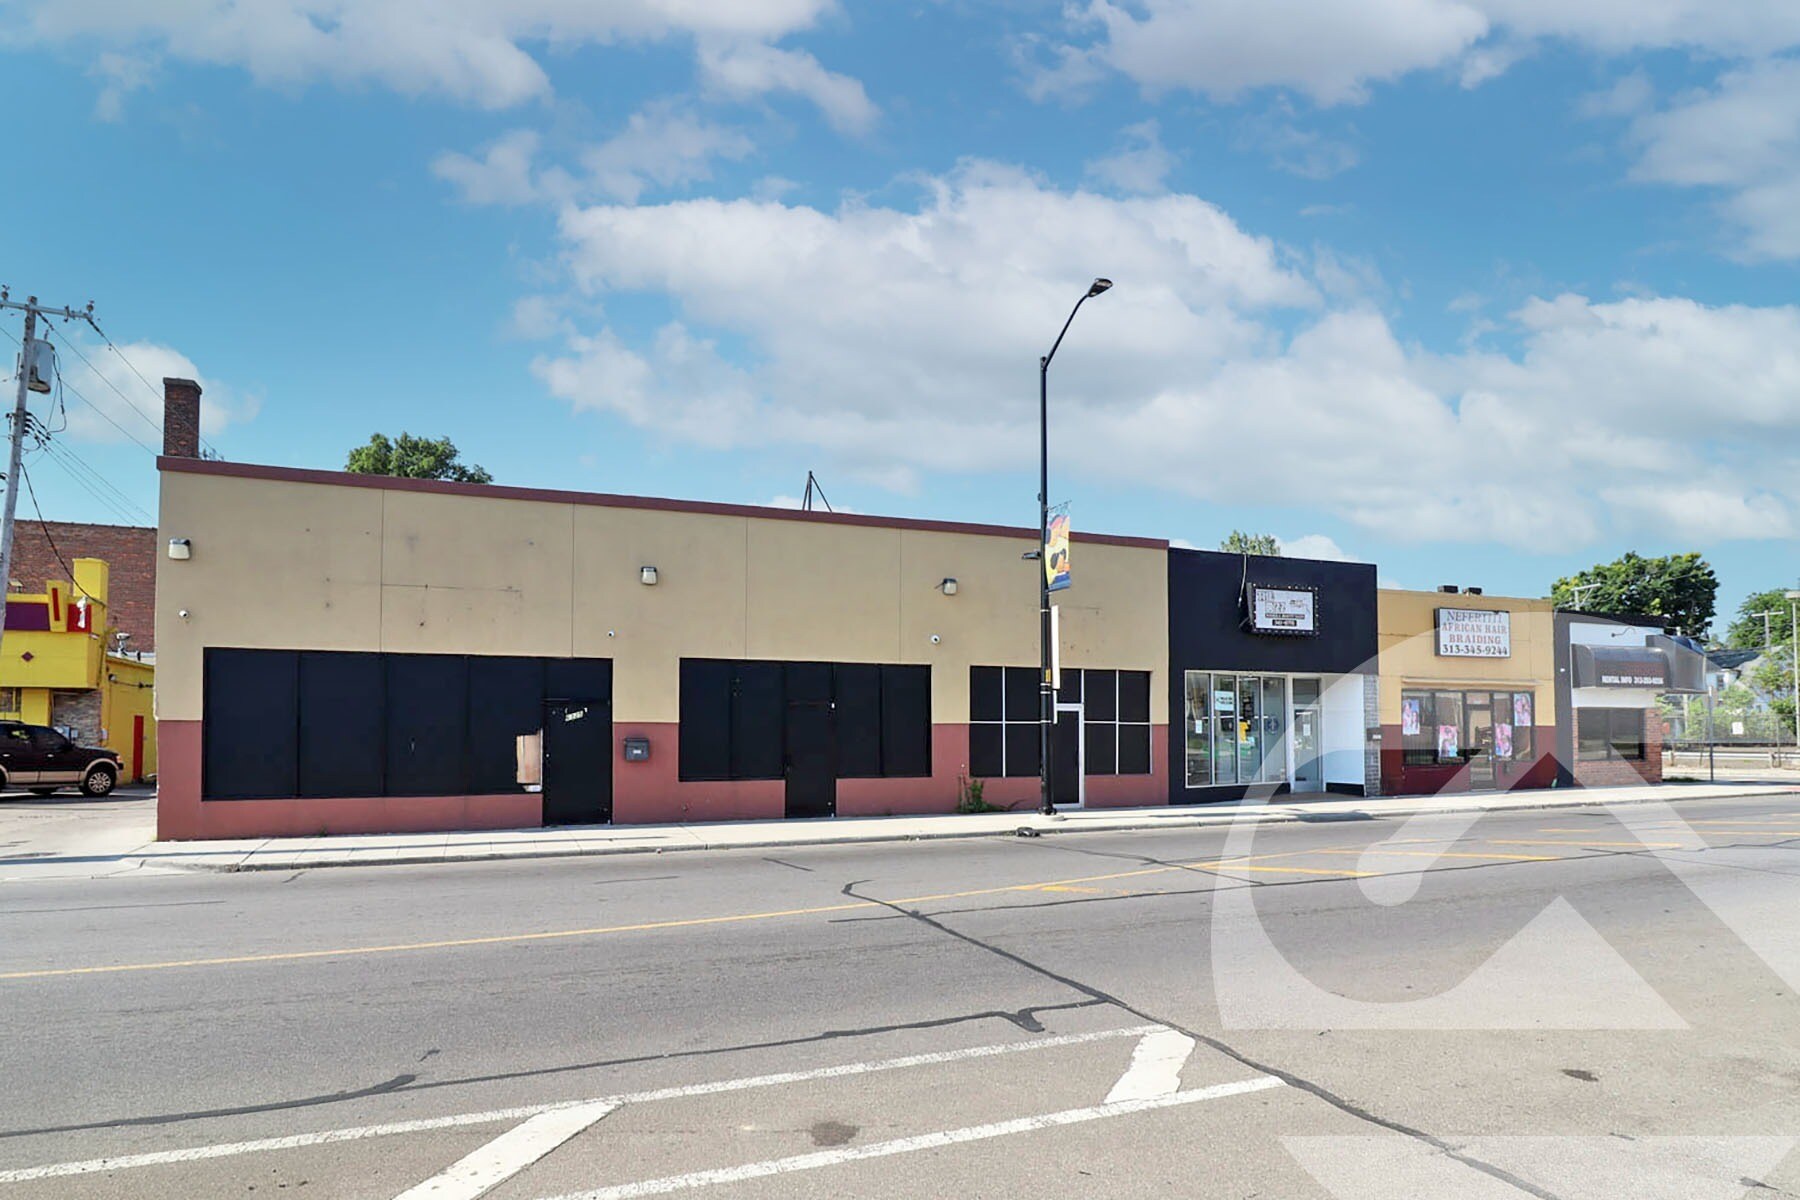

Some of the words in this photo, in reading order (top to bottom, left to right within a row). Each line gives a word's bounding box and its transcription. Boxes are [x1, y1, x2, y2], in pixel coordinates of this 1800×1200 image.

[1442, 621, 1482, 632] AFRICAN
[1485, 624, 1507, 634] HAIR
[1449, 633, 1501, 644] BRAIDING
[1442, 643, 1507, 655] 313-345-9244
